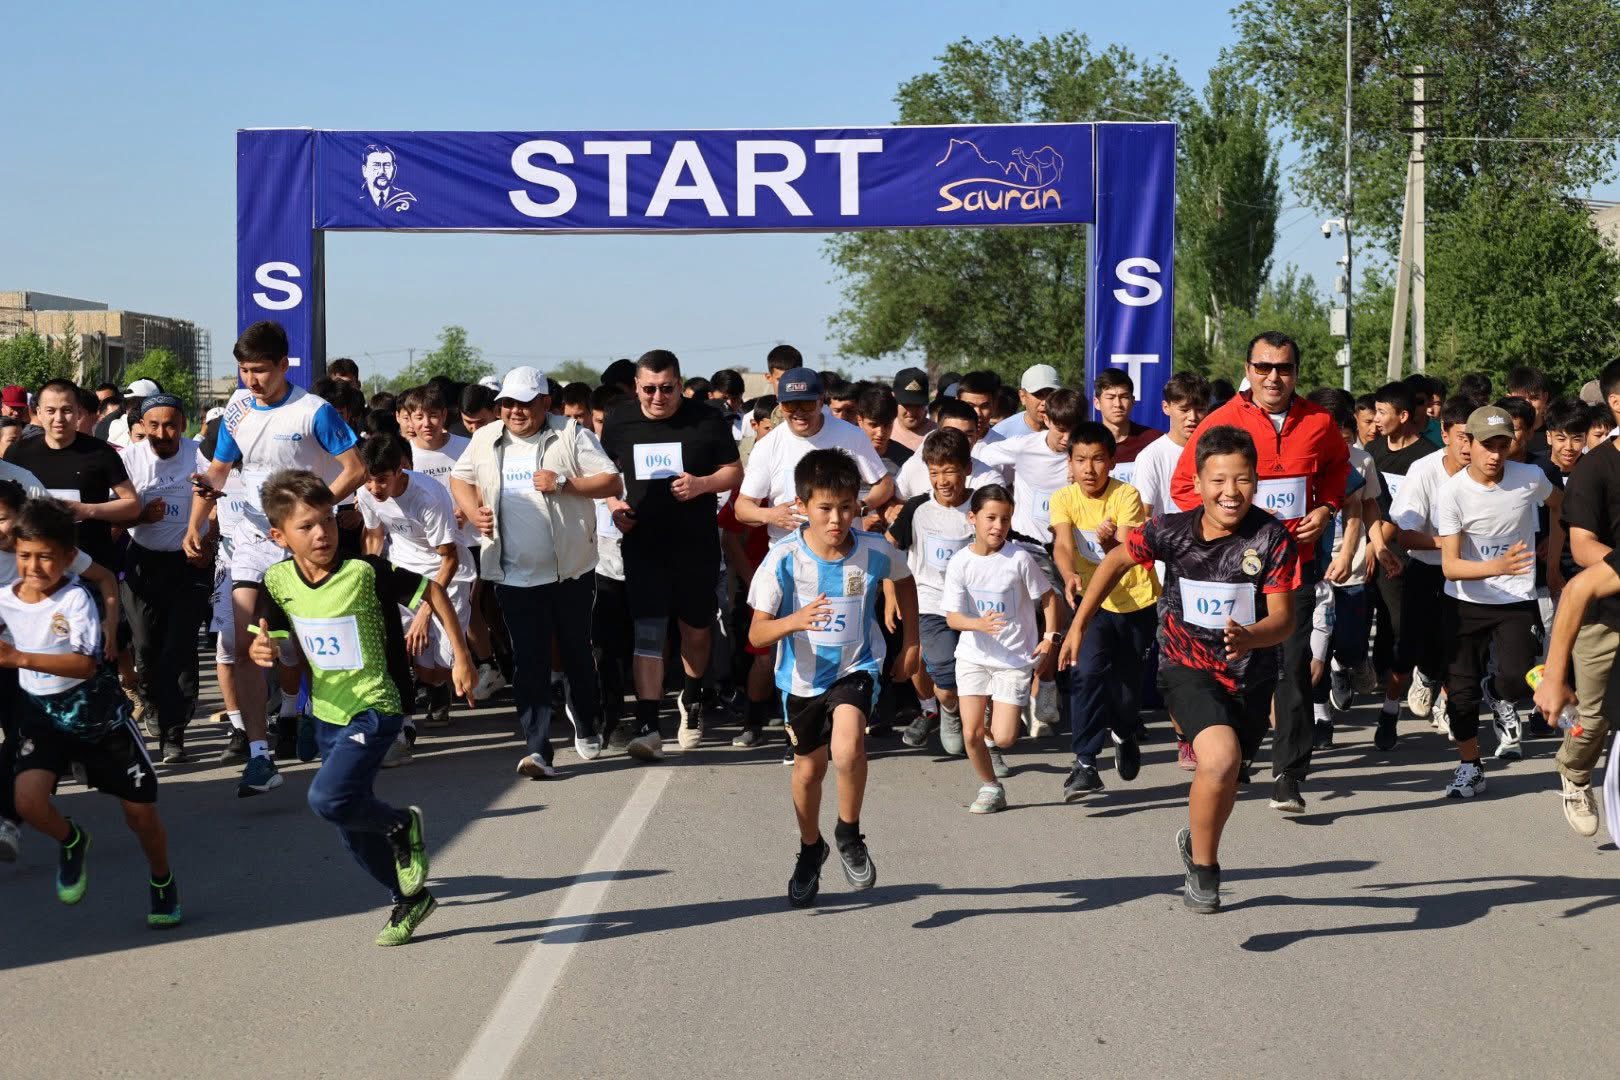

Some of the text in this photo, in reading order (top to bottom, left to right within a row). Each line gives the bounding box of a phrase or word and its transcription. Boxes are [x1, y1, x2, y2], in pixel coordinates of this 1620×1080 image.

[508, 140, 883, 217] START
[936, 177, 1062, 212] Sauran
[252, 261, 303, 311] S
[1113, 257, 1163, 307] S
[1110, 353, 1160, 402] T
[422, 466, 453, 475] PRADA
[645, 454, 672, 468] 096
[1266, 492, 1295, 509] 059
[1481, 544, 1509, 557] 075
[977, 600, 1006, 613] 020
[1197, 597, 1237, 616] 027
[816, 614, 847, 633] 25
[304, 635, 341, 656] 023
